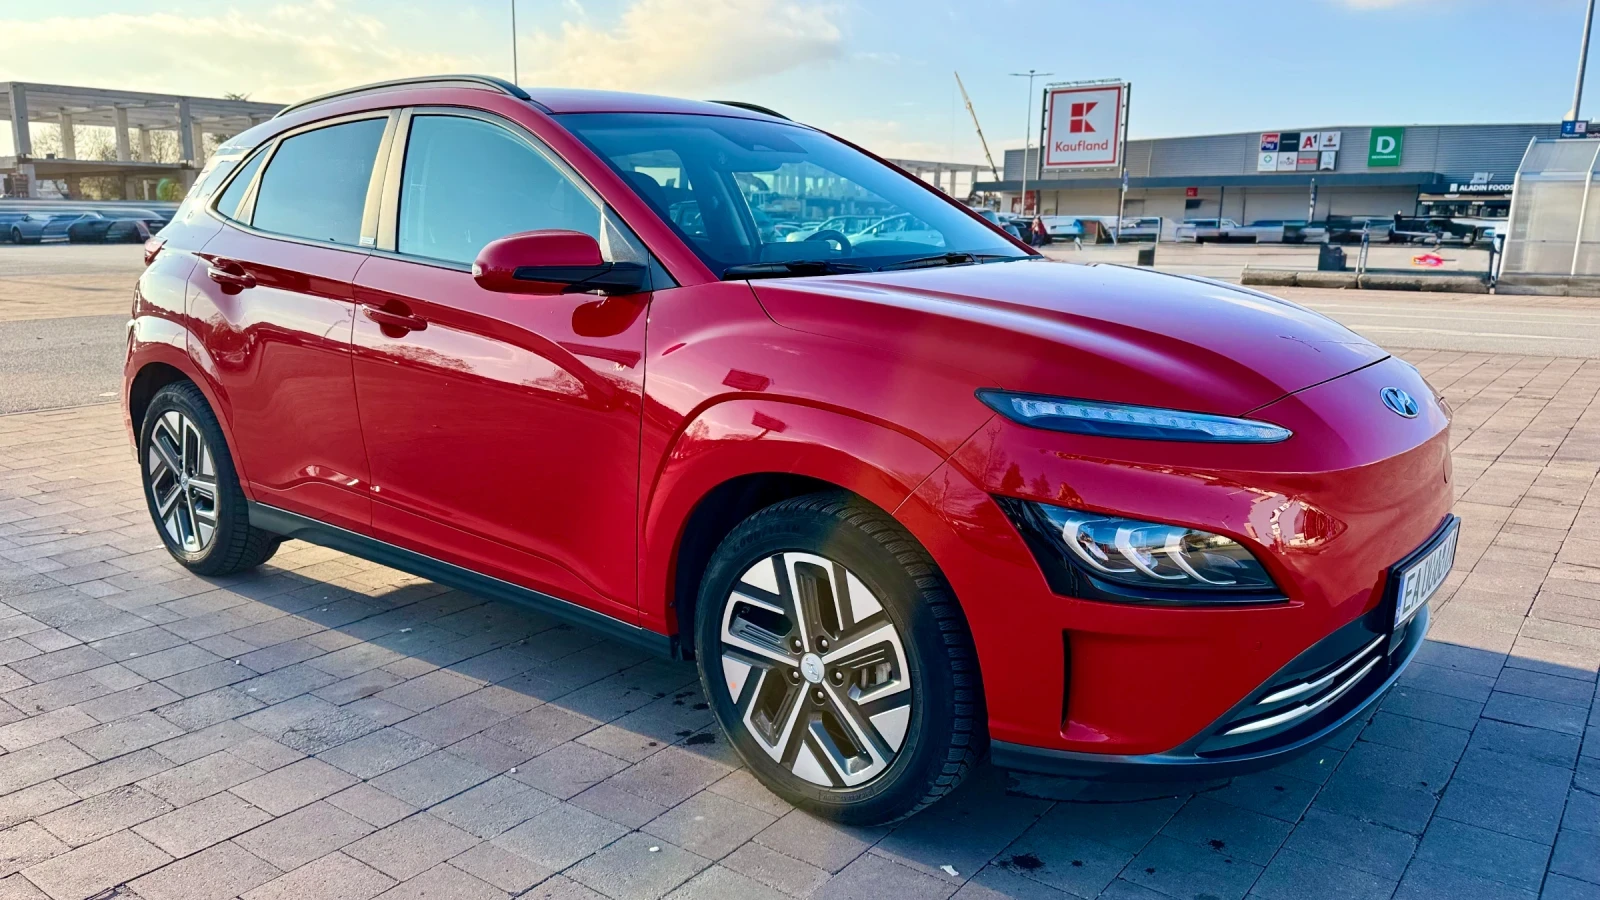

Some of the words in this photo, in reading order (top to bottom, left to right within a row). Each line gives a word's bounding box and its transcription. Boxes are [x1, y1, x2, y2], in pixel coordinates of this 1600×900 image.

[1055, 139, 1108, 152] Kaufland
[1302, 134, 1318, 149] A1
[1375, 136, 1396, 153] D
